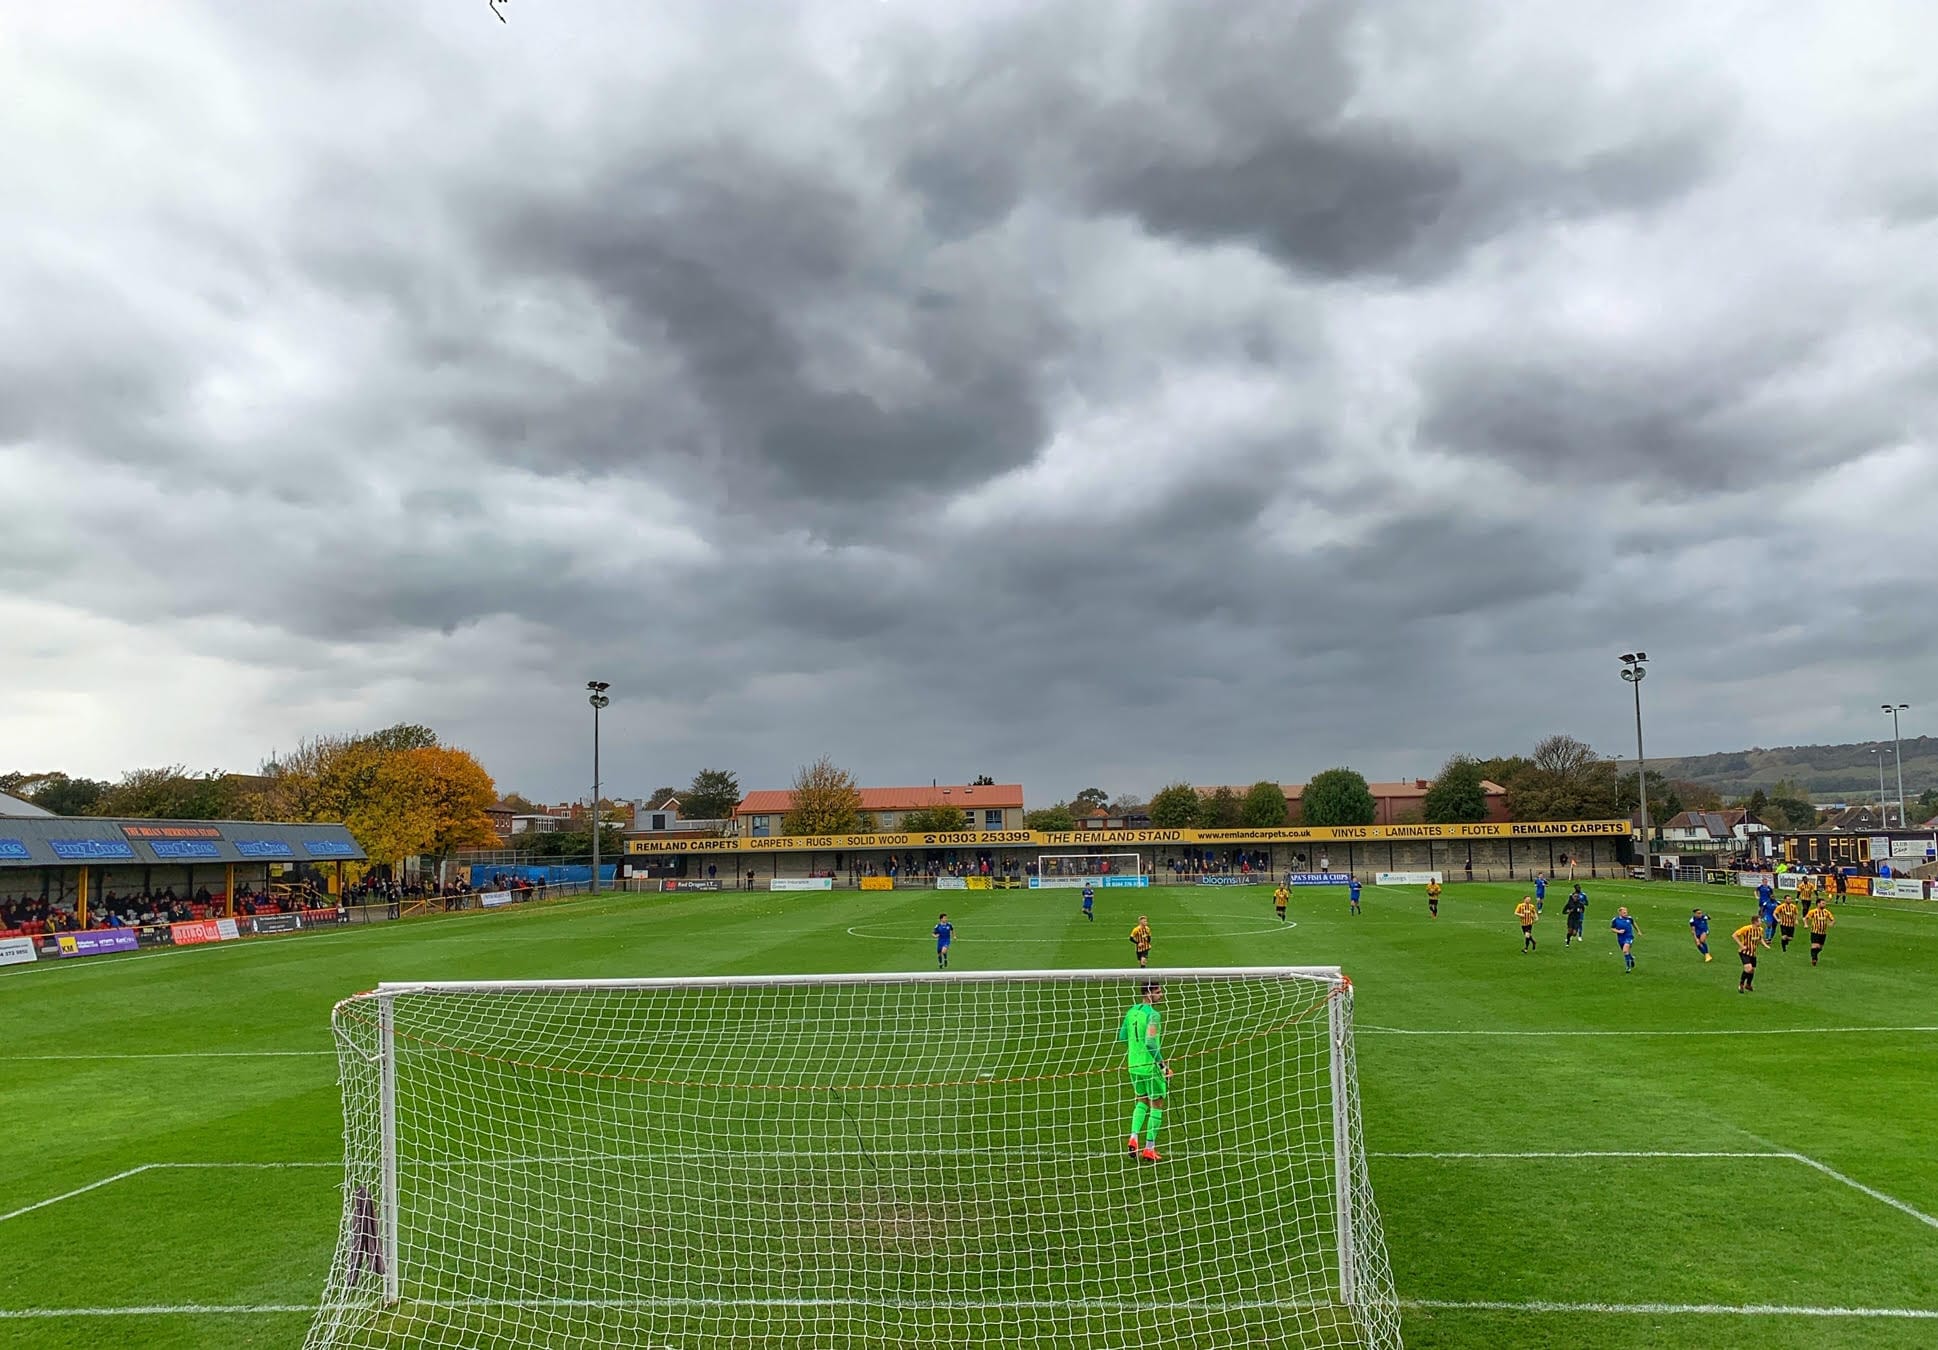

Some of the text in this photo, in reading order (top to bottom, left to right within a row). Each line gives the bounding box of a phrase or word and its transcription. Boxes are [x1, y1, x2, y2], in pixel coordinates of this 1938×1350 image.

[1047, 830, 1181, 843] THE REMLAND STAND
[1198, 823, 1624, 840] www.remlandcarpets.co.uk VINYLS LAMINATES FLOTEX REMLAND CARPETS
[637, 831, 1031, 852] REMLAND CARPETS CARPETS RUGS SOLID WOOD 01303 253399
[1202, 874, 1236, 885] blooms
[1132, 1020, 1140, 1042] 1
